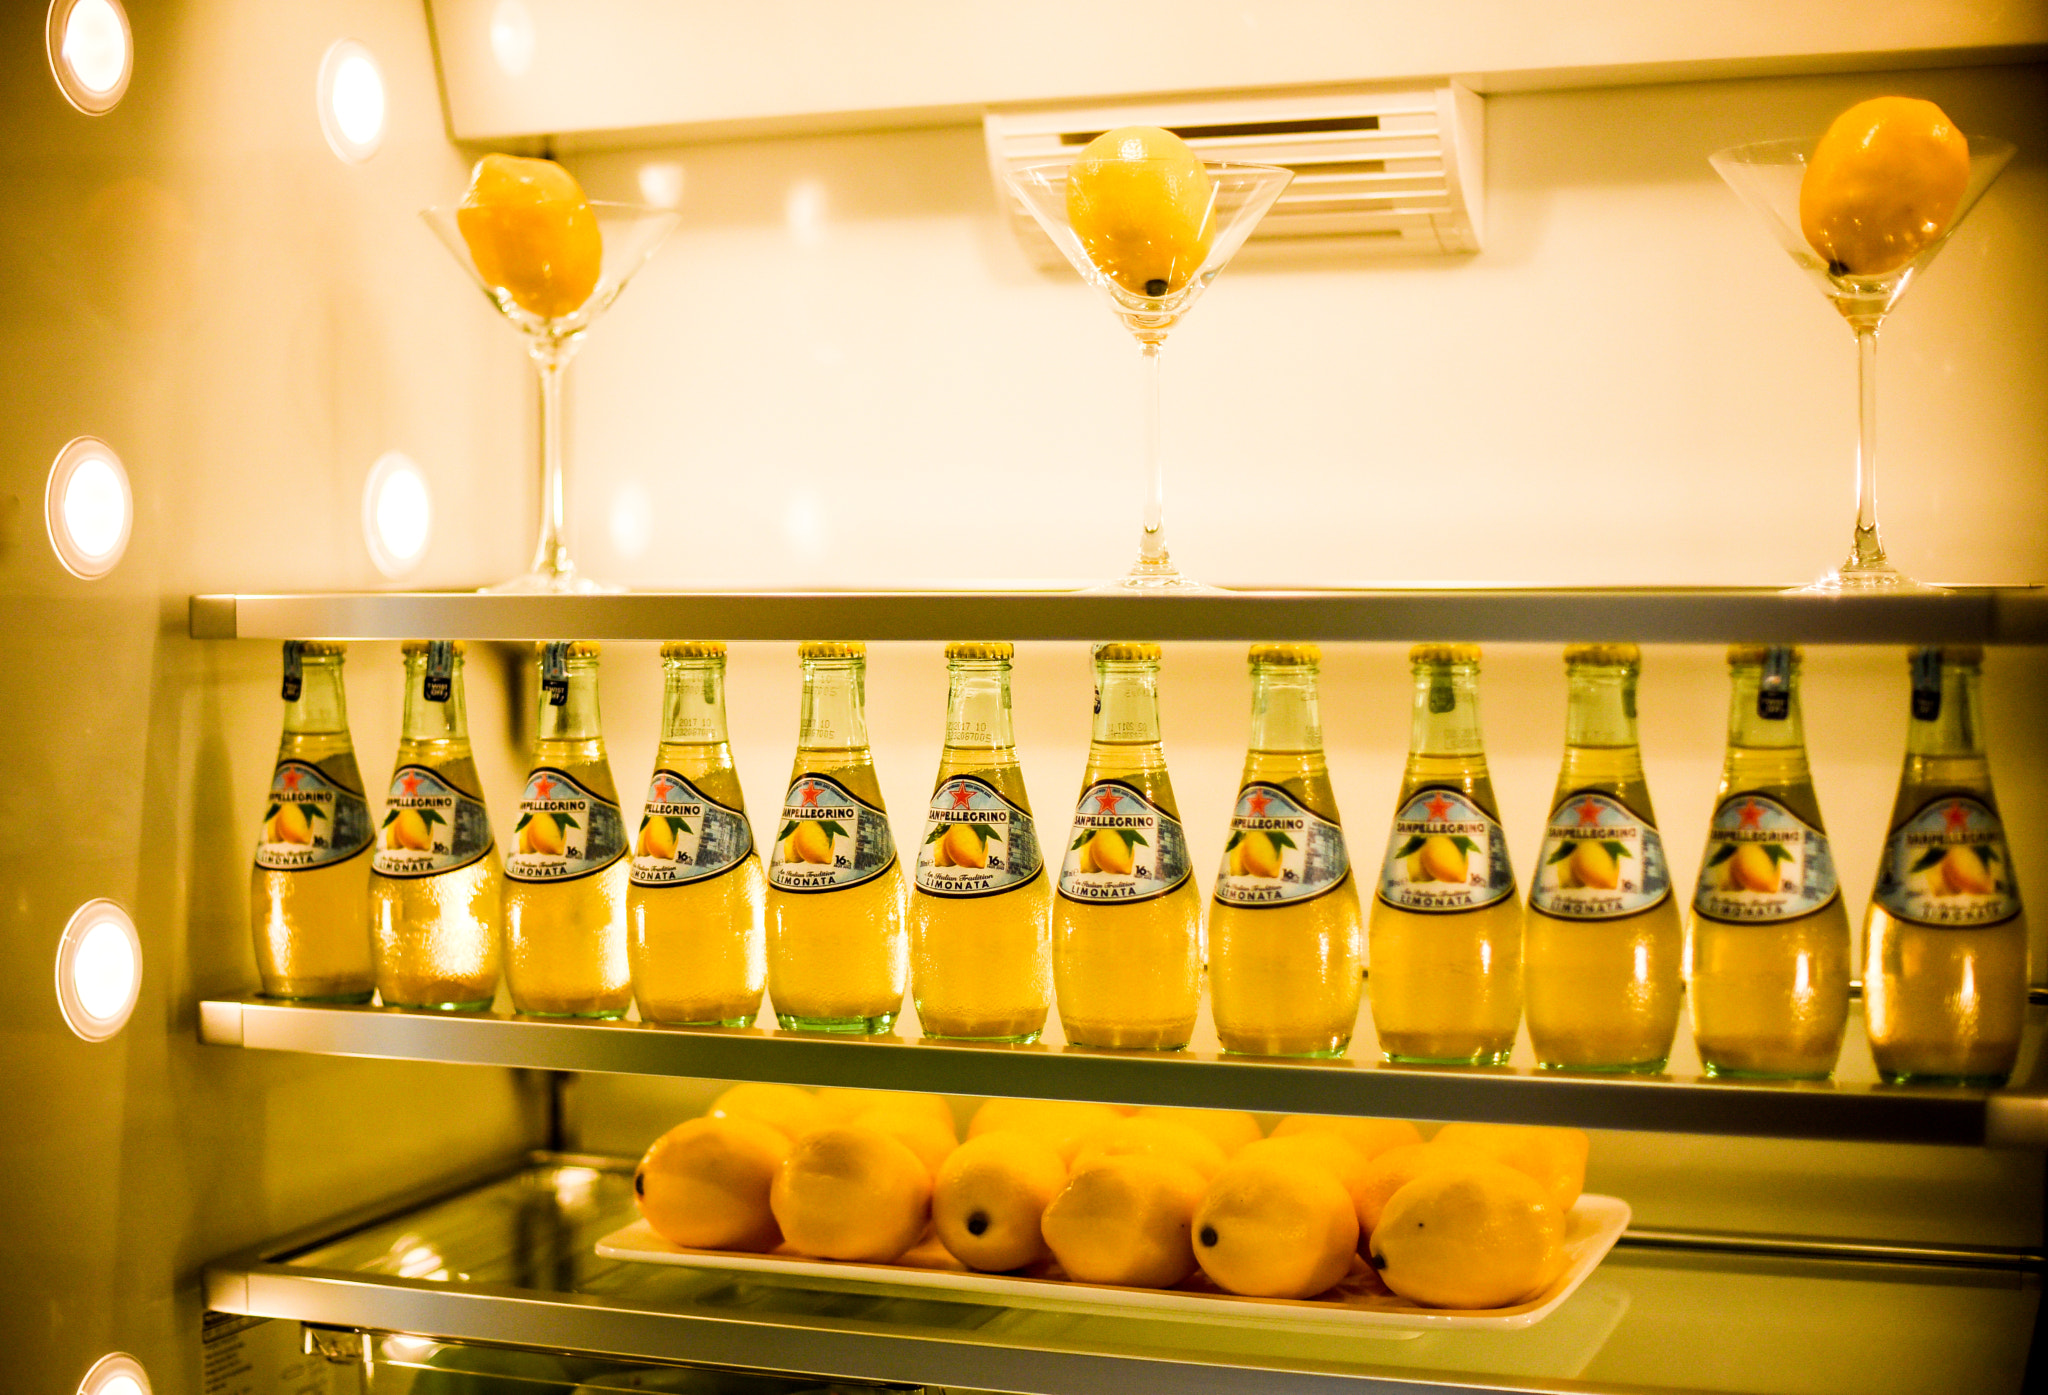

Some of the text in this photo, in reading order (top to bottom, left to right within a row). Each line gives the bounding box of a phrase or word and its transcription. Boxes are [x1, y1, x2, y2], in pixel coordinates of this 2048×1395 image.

[976, 722, 987, 731] 10
[929, 810, 1007, 822] SANPELLEGRINO
[1075, 814, 1154, 827] SANPELLEGRINO
[777, 874, 836, 886] LIMONATA
[926, 877, 990, 890] LIMONATA
[1072, 884, 1137, 897] LIMONATA
[1221, 888, 1282, 900] LIMONATA
